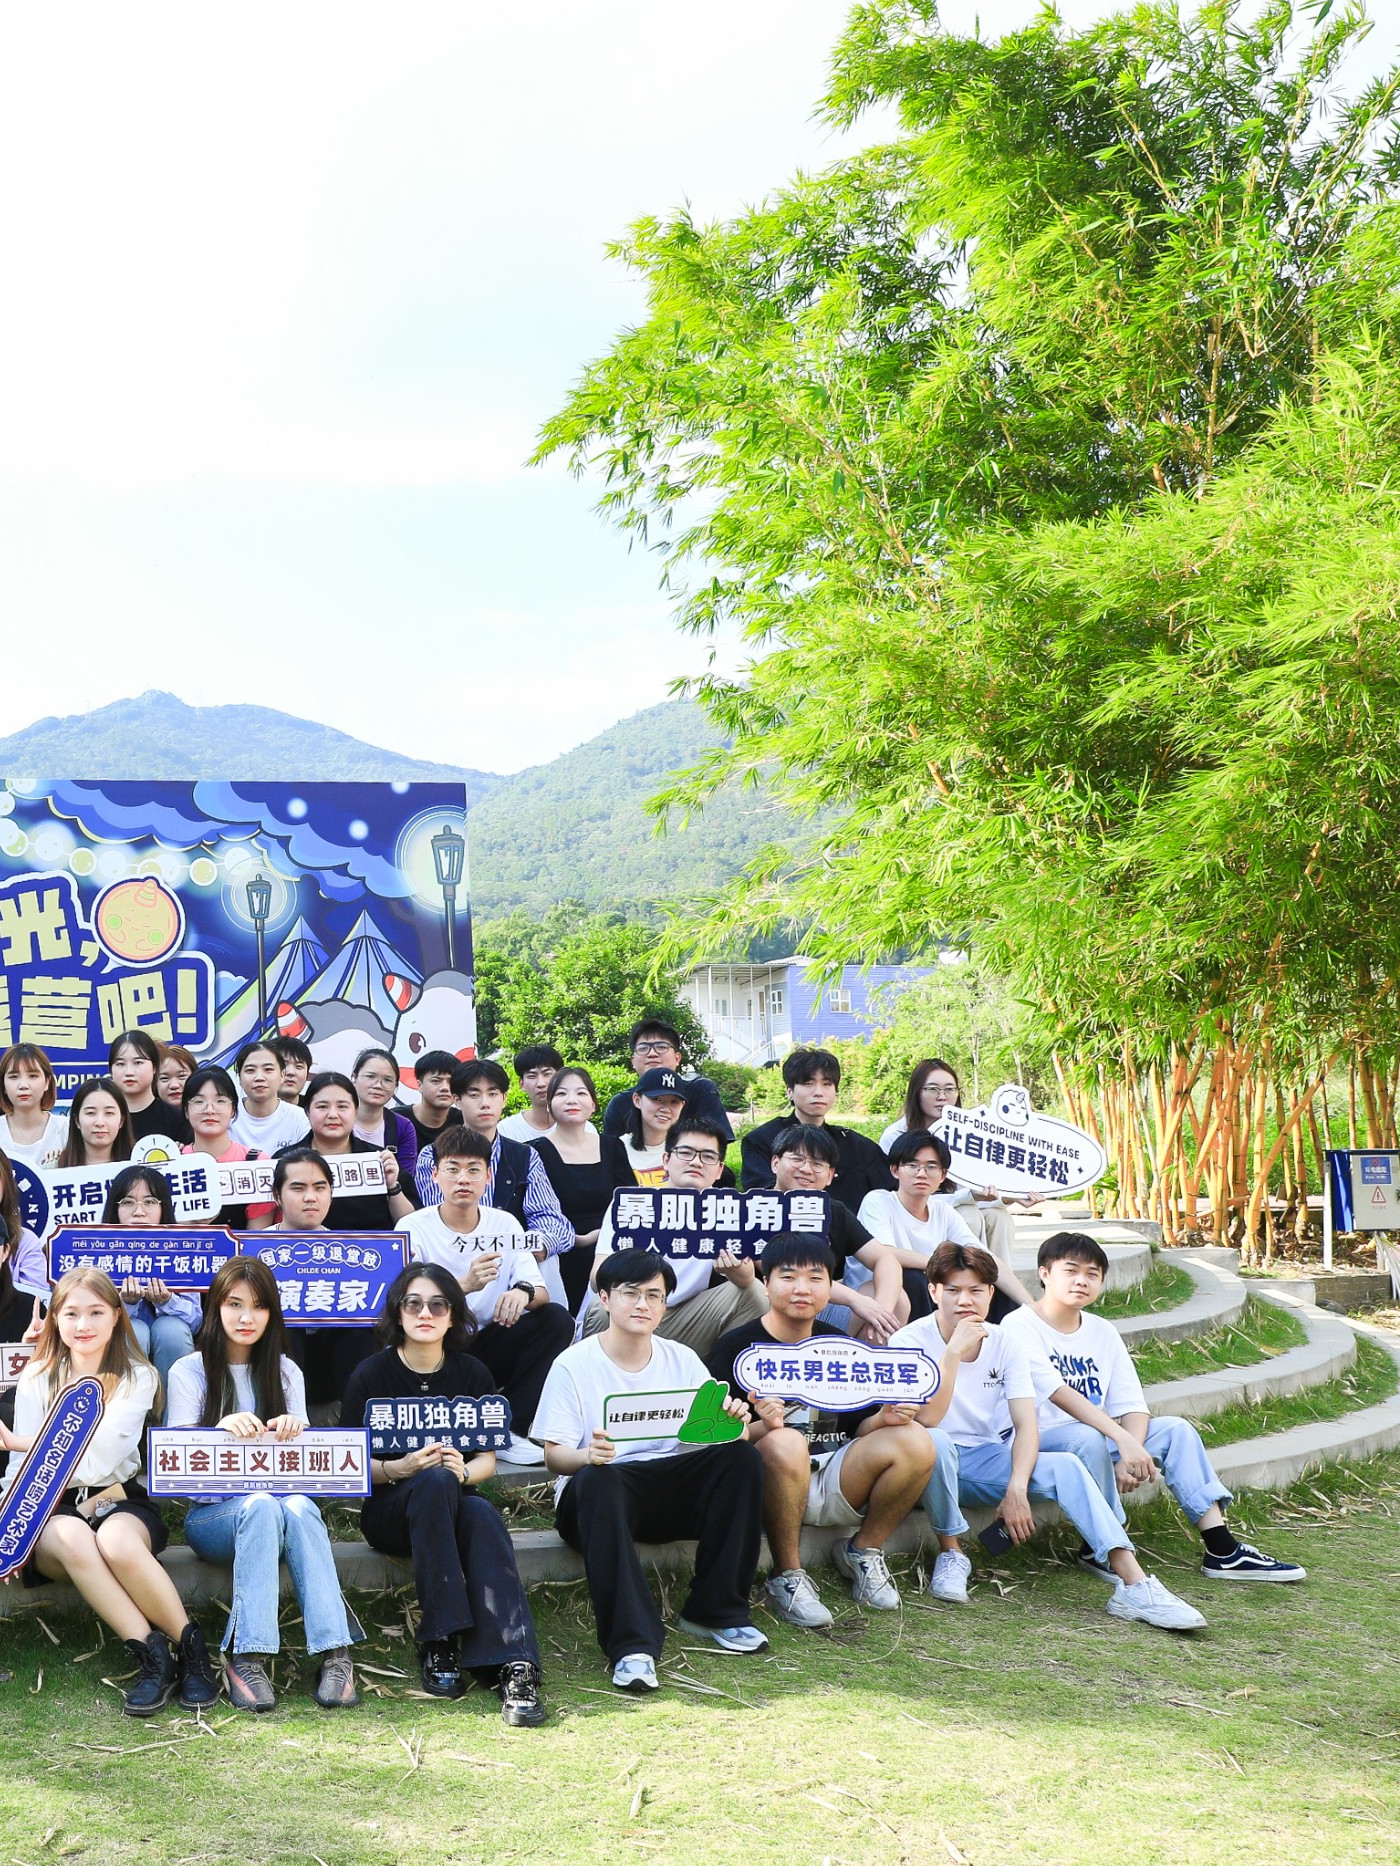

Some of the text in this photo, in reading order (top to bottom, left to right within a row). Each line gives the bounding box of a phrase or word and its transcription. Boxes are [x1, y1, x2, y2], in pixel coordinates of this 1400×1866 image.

[947, 1110, 1080, 1160] SELF-DISCIPLINE WITH EASE
[943, 1125, 1069, 1186] 让自律更轻松
[54, 1210, 96, 1226] START
[183, 1198, 210, 1212] LIFE
[616, 1193, 826, 1233] 暴肌独角兽
[451, 1233, 541, 1253] 今天不上班
[59, 1255, 228, 1273] 没有感情的干饭机器
[260, 1245, 379, 1268] 国家一级退堂鼓
[297, 1267, 341, 1275] CHLOE CHAN
[755, 1358, 919, 1386] 快乐男生总冠军
[369, 1401, 507, 1430] 暴肌独角兽
[609, 1408, 684, 1423] 让自律更轻松
[159, 1449, 359, 1472] 社会主义接班人
